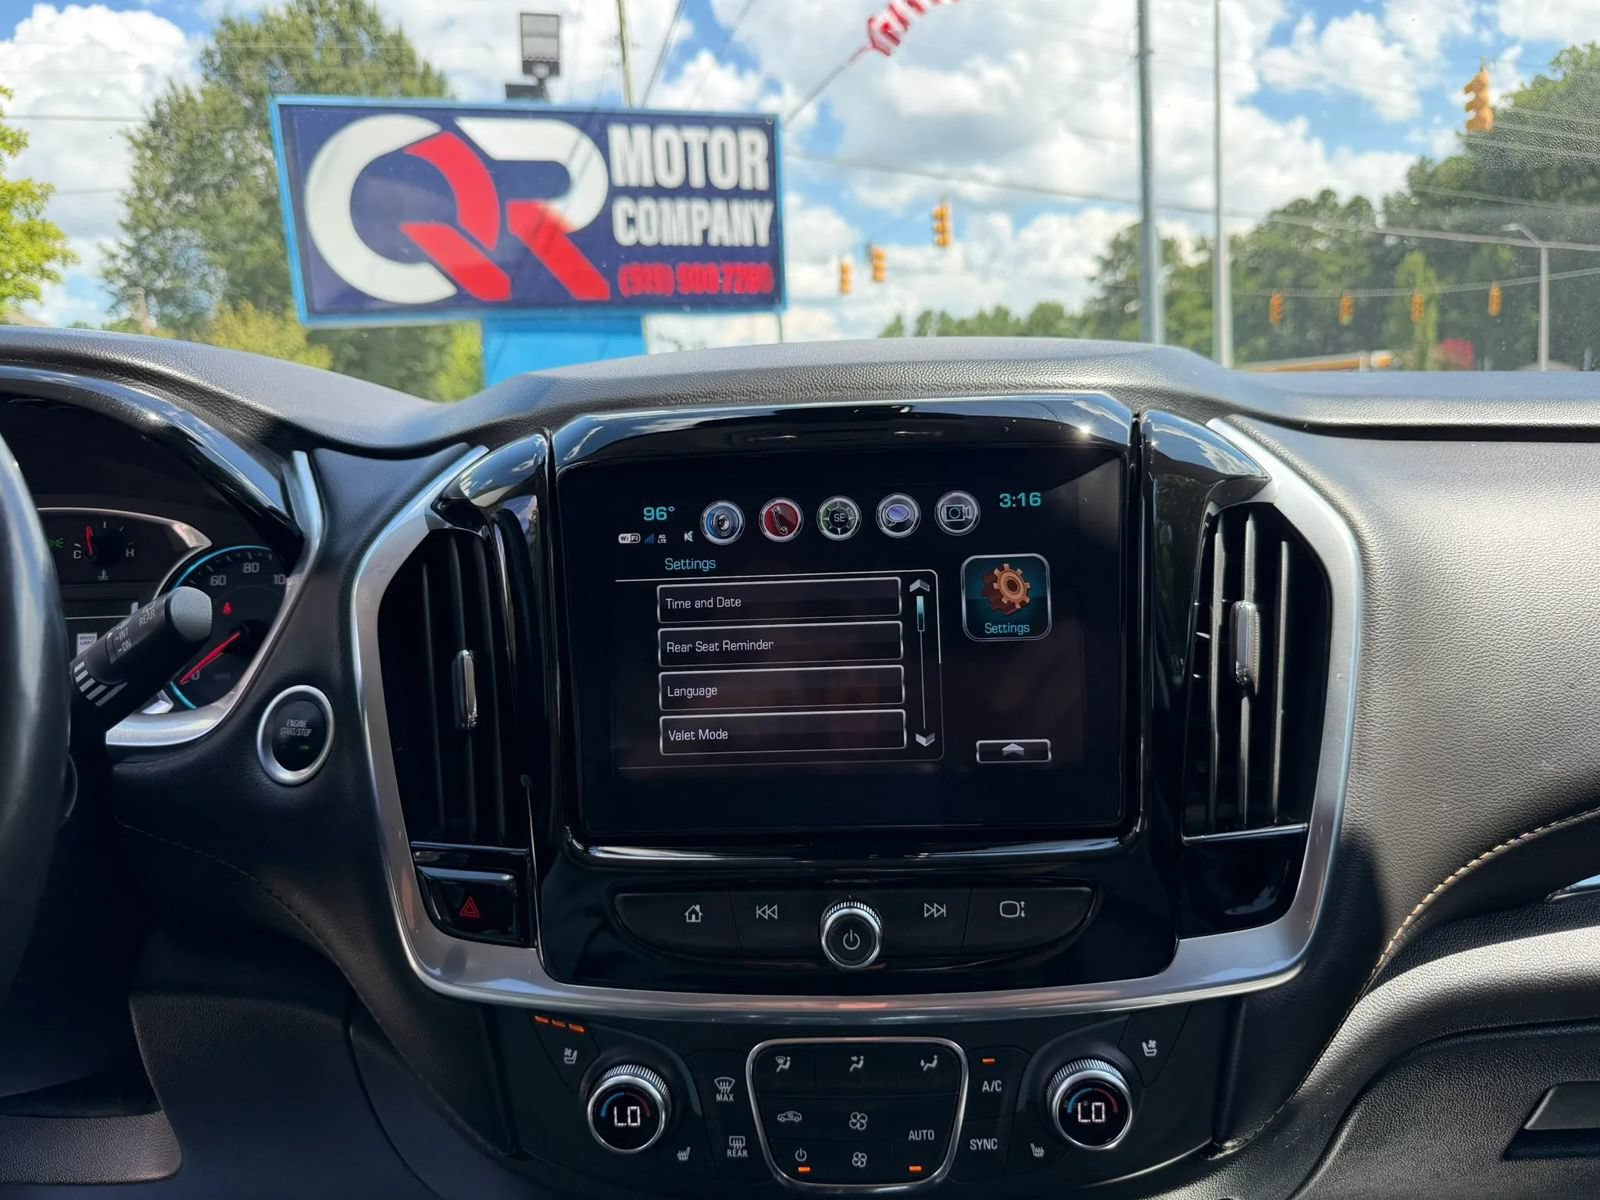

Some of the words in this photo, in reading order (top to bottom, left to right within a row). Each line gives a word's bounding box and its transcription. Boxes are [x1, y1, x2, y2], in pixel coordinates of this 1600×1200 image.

[607, 123, 770, 191] MOTOR
[305, 113, 612, 304] QR
[612, 196, 774, 247] COMPANY
[999, 491, 1042, 508] 3:16
[643, 506, 675, 521] 96°
[833, 513, 846, 523] SE
[125, 548, 135, 558] H
[243, 562, 260, 573] 80
[664, 557, 716, 572] Settings
[210, 575, 227, 586] 60
[273, 574, 288, 585] 10
[665, 598, 691, 609] Time
[694, 597, 714, 608] and
[716, 596, 742, 608] Date
[984, 622, 1030, 635] Settings
[666, 641, 692, 653] Rear
[695, 640, 720, 652] Seat
[722, 639, 774, 651] Reminder
[667, 686, 718, 699] Language
[668, 729, 696, 741] Valet
[698, 728, 729, 740] Mode
[982, 1080, 1002, 1092] A/C
[716, 1094, 734, 1102] MAX
[614, 1105, 641, 1127] LO
[1077, 1102, 1106, 1123] LO
[908, 1129, 935, 1141] AUTO
[969, 1138, 998, 1150] SYNC
[726, 1149, 749, 1158] REAR
